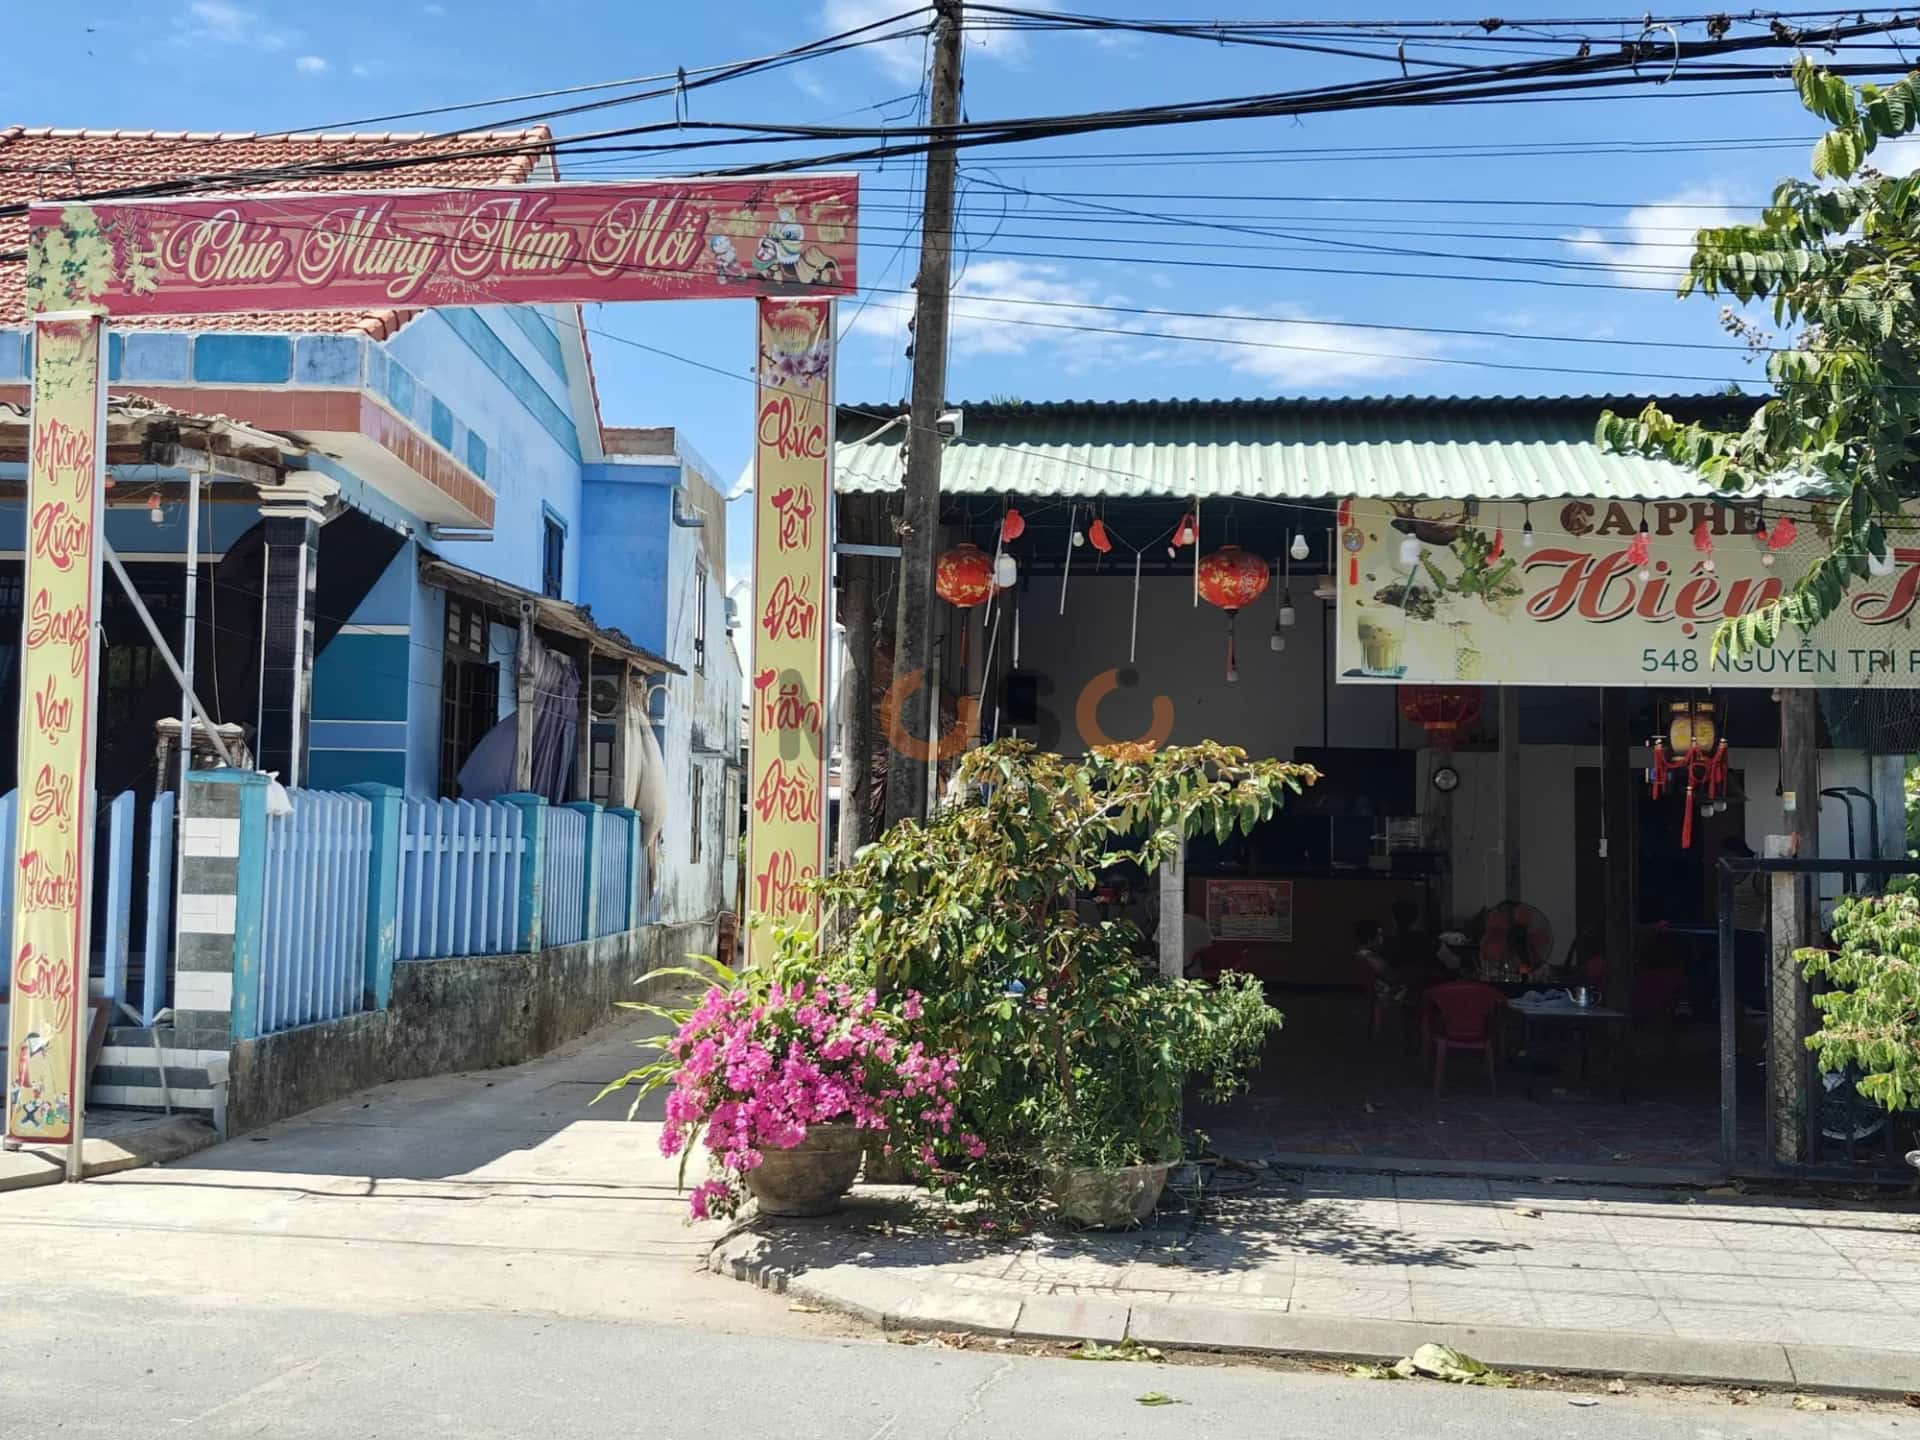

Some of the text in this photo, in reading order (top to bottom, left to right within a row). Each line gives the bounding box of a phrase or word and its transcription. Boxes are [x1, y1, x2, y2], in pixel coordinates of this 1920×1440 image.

[167, 191, 701, 298] Chúc Mừng Năm Mới
[759, 394, 827, 459] Chúc
[33, 502, 86, 568] Xuân
[771, 485, 814, 549] Tết
[27, 588, 87, 674] Sang
[763, 576, 816, 641] Đến
[1641, 649, 1699, 672] 548
[1711, 639, 1837, 673] NGUYỄN
[1847, 649, 1896, 673] TRI
[36, 674, 71, 741] Vạn
[30, 764, 69, 829] Sự
[755, 759, 817, 822] Điều
[20, 851, 76, 909] Thành
[17, 942, 71, 1029] Công
